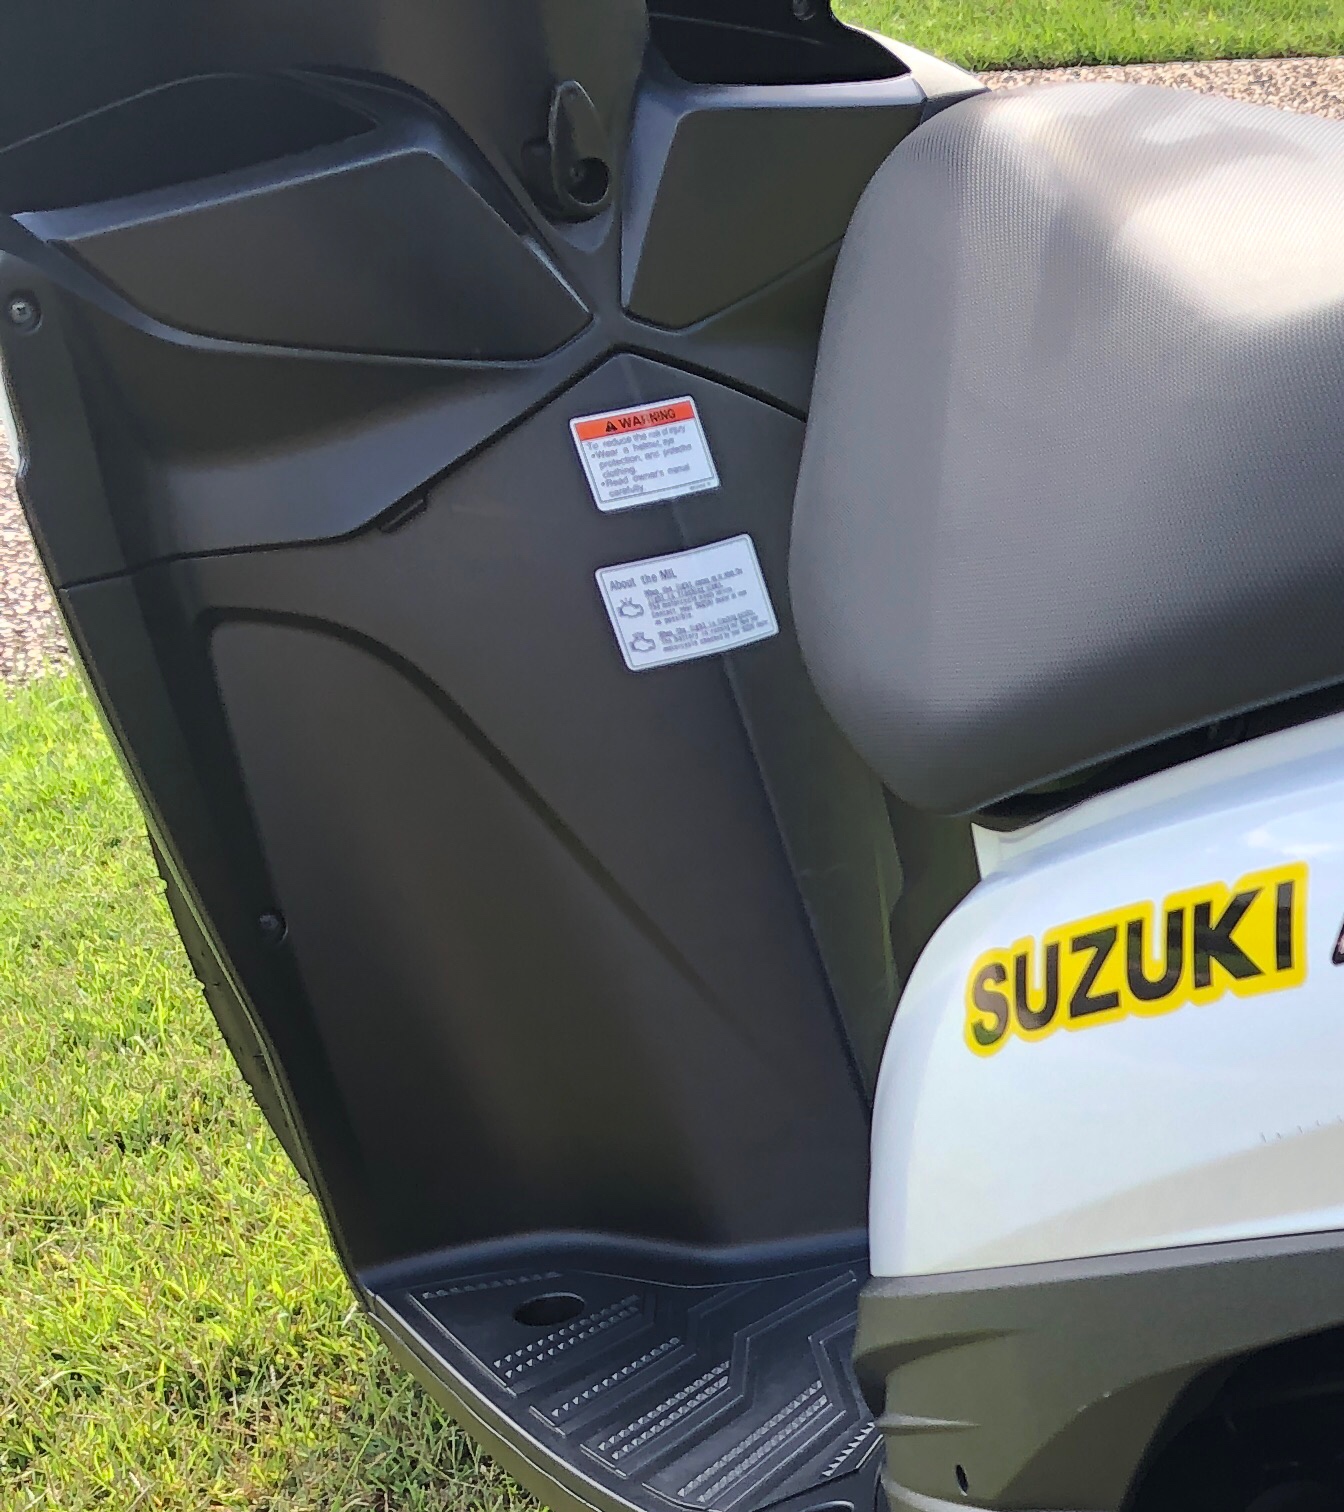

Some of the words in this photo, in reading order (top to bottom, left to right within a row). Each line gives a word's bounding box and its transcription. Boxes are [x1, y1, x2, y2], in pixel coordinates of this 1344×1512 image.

[610, 577, 637, 591] About
[640, 573, 658, 585] the
[969, 878, 1296, 1045] SUZUKI
